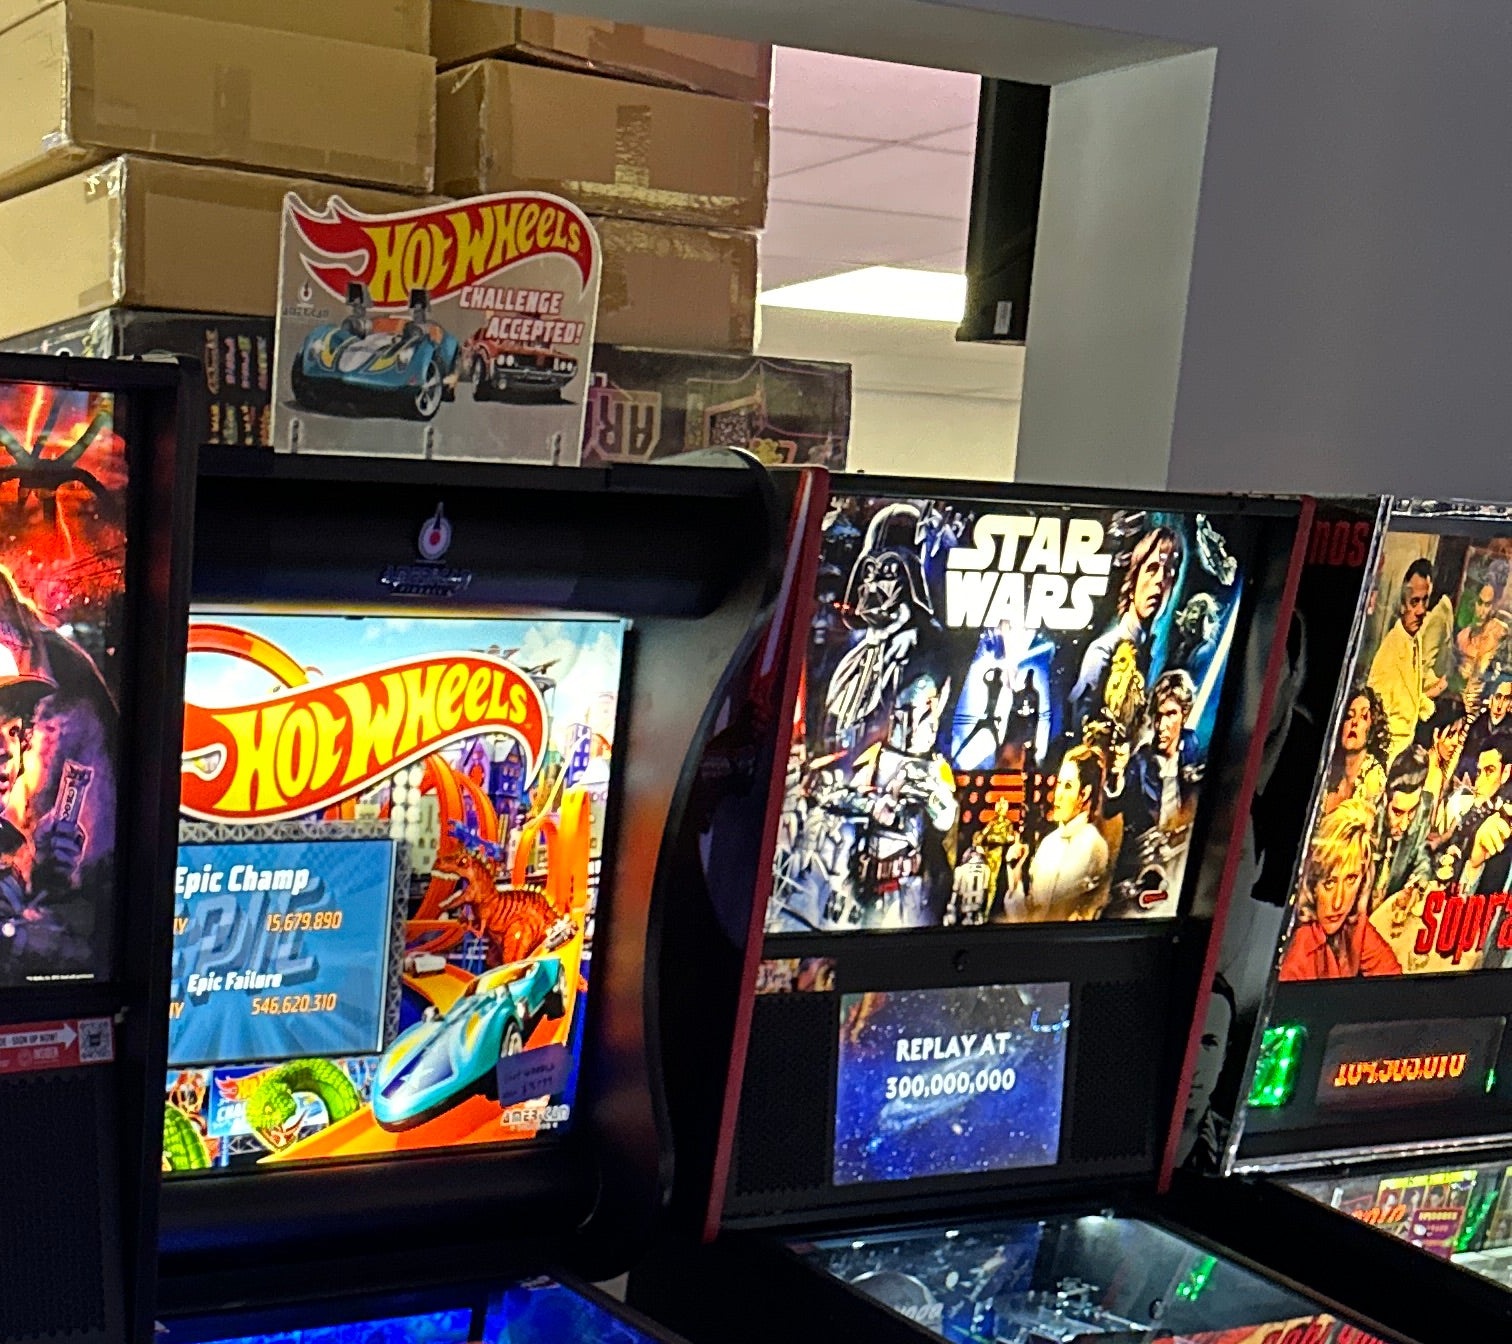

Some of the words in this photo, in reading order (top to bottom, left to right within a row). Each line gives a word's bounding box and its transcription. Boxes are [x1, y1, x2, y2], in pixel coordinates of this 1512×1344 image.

[363, 220, 453, 301] HOT
[459, 286, 563, 314] CHALLENGE
[486, 316, 584, 345] ACCEPTED!
[947, 514, 1113, 575] STAR
[946, 570, 1109, 630] WARS
[211, 701, 346, 812] HOT
[335, 663, 527, 786] WHEELS
[175, 864, 224, 899] Epic
[228, 864, 310, 896] Champ
[187, 971, 223, 997] Epic
[225, 970, 283, 991] Failure
[896, 1033, 977, 1062] REPLAY
[978, 1032, 1012, 1057] AT
[885, 1068, 1016, 1099] 300,000,000
